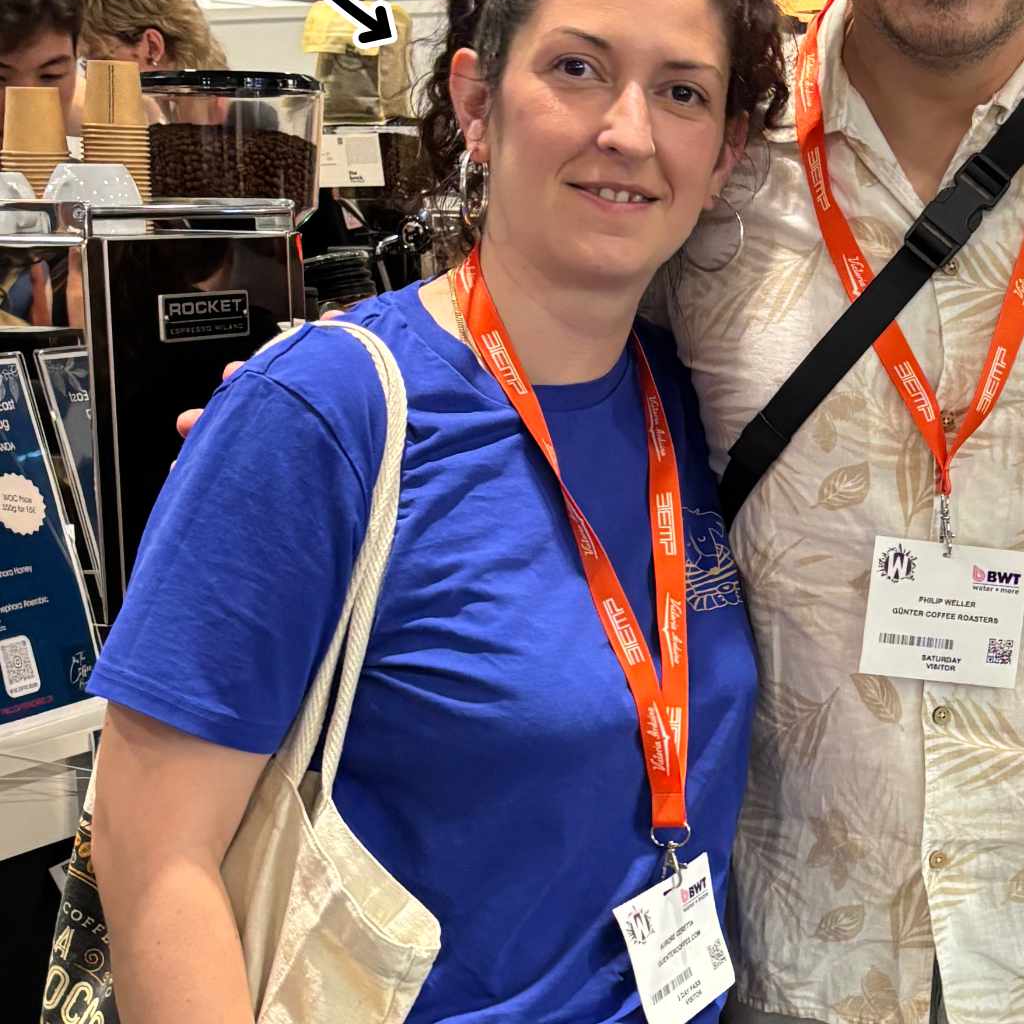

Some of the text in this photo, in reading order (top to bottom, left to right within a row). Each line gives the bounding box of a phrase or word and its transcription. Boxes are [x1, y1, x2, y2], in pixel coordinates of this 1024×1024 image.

[169, 298, 242, 316] ROCKET
[987, 571, 1022, 585] BWT
[918, 596, 976, 608] PHILIP WELLER
[892, 607, 999, 624] GÜNTER COFFEE ROASTERS
[921, 654, 962, 664] SATURDAY
[926, 664, 956, 672] VISITOR
[689, 877, 707, 898] BWT
